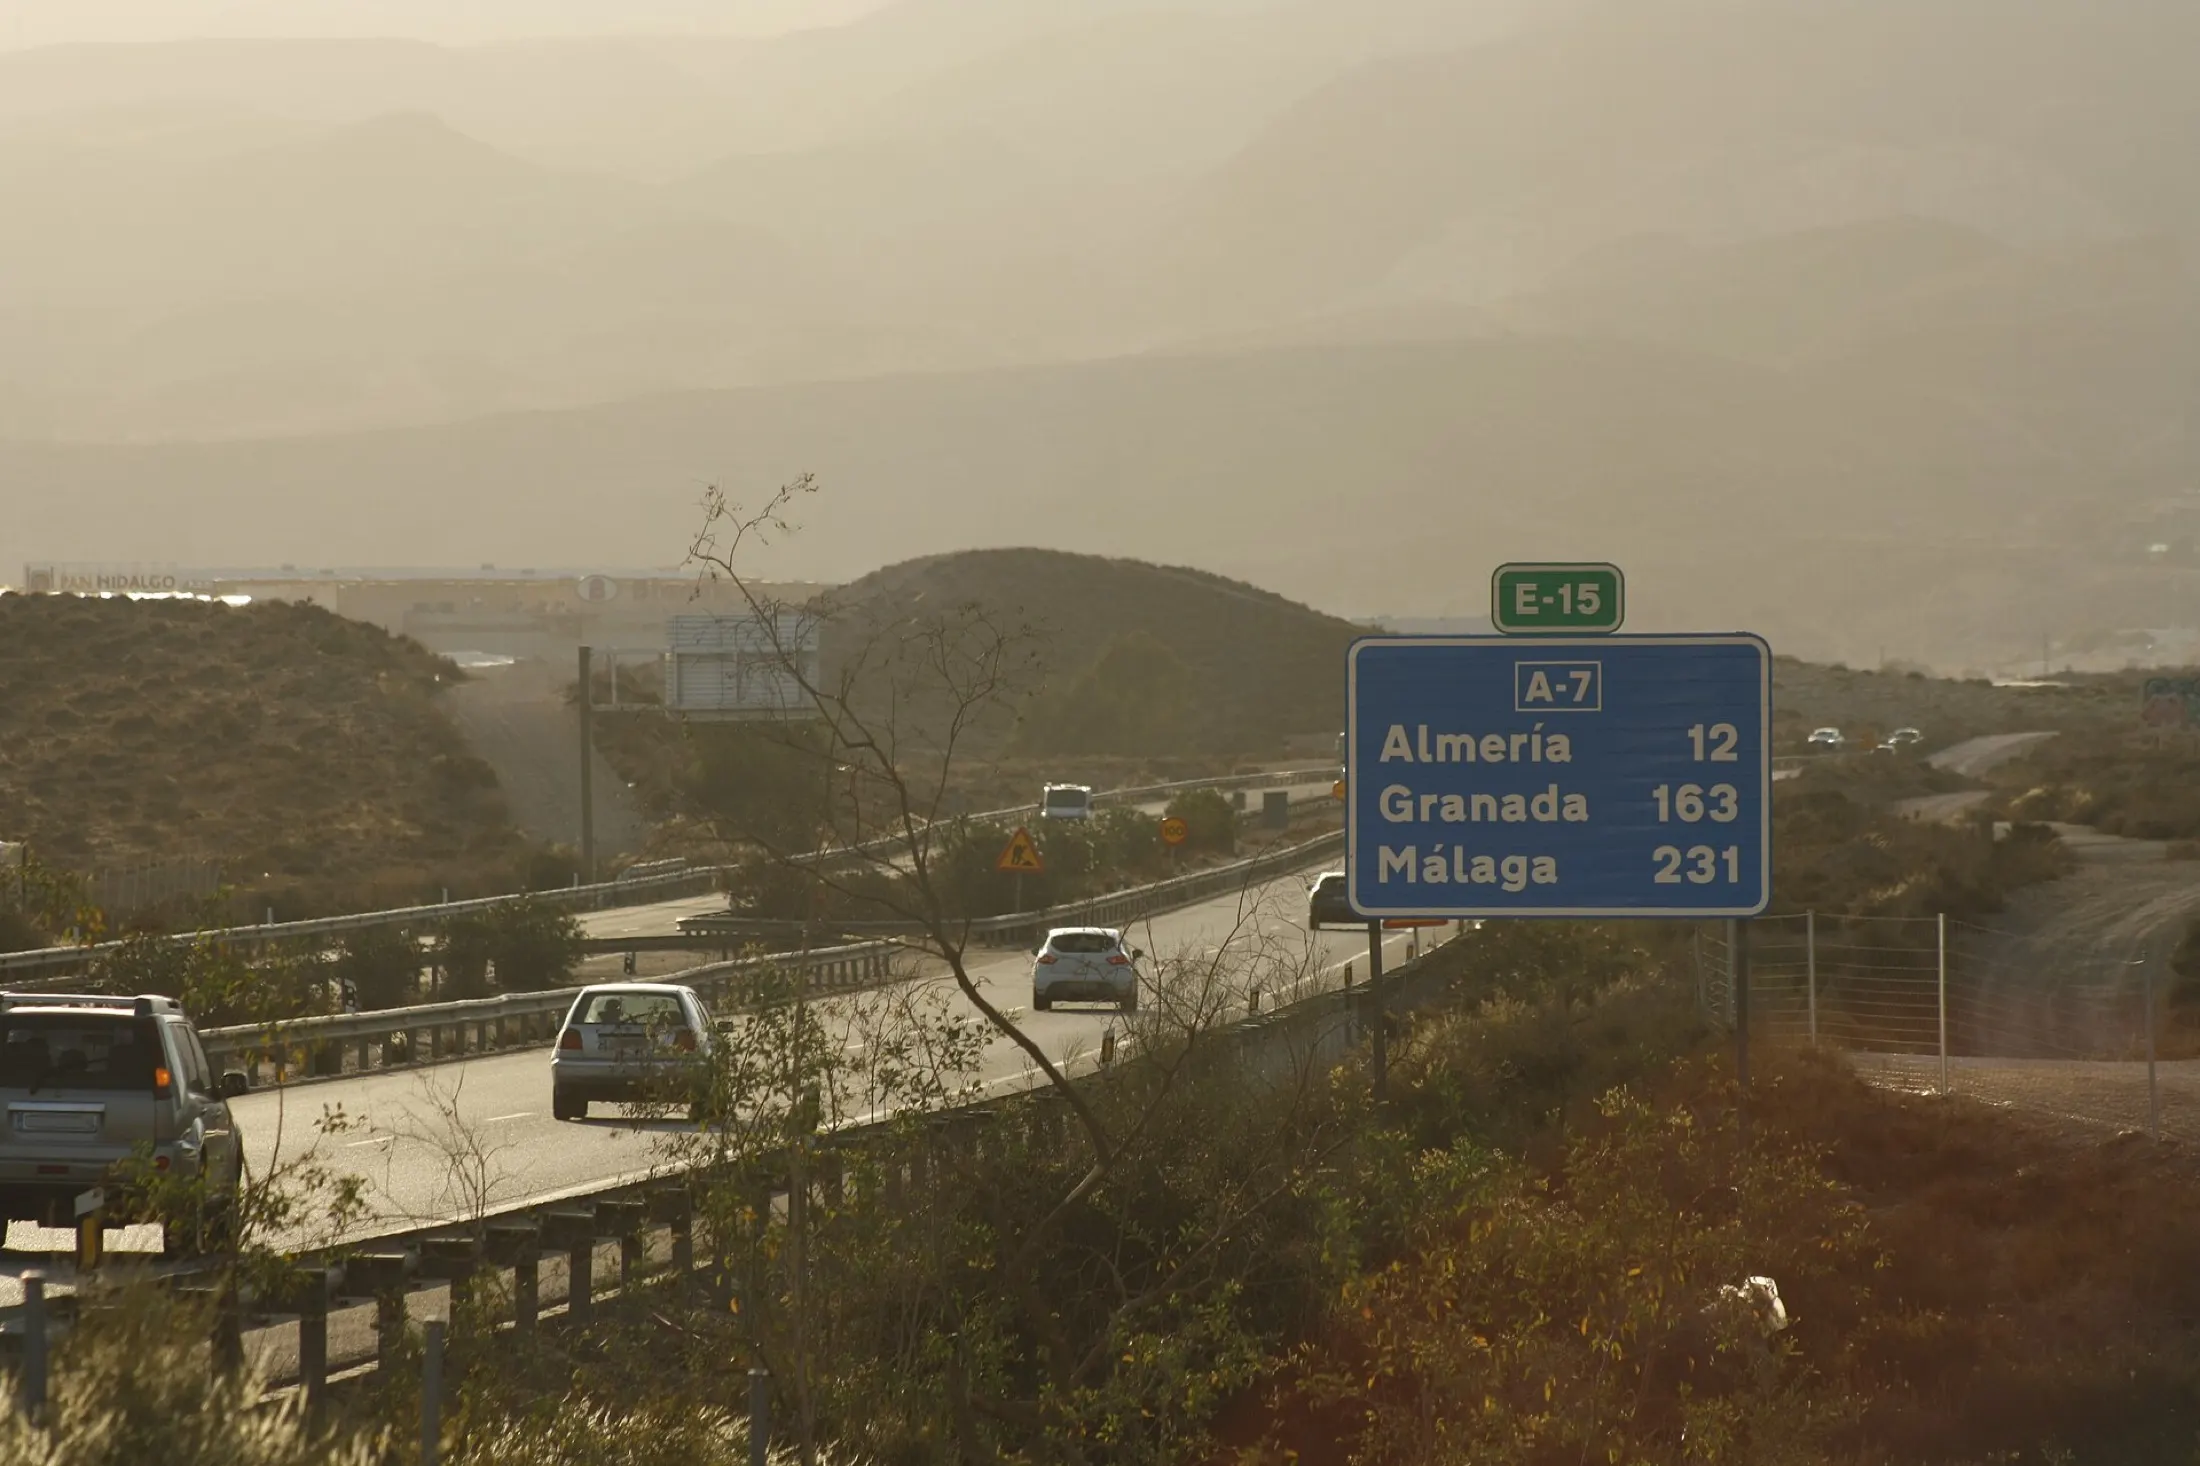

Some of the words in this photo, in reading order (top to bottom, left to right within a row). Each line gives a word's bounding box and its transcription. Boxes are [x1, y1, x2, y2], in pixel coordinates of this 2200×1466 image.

[1515, 583, 1601, 615] E-15
[1524, 671, 1592, 702] A-7
[1379, 722, 1573, 763] Almería
[1687, 723, 1739, 762] 12
[1379, 784, 1590, 823] Granada
[1652, 784, 1739, 823] 163
[1378, 843, 1559, 892] Málaga
[1652, 845, 1739, 884] 231
